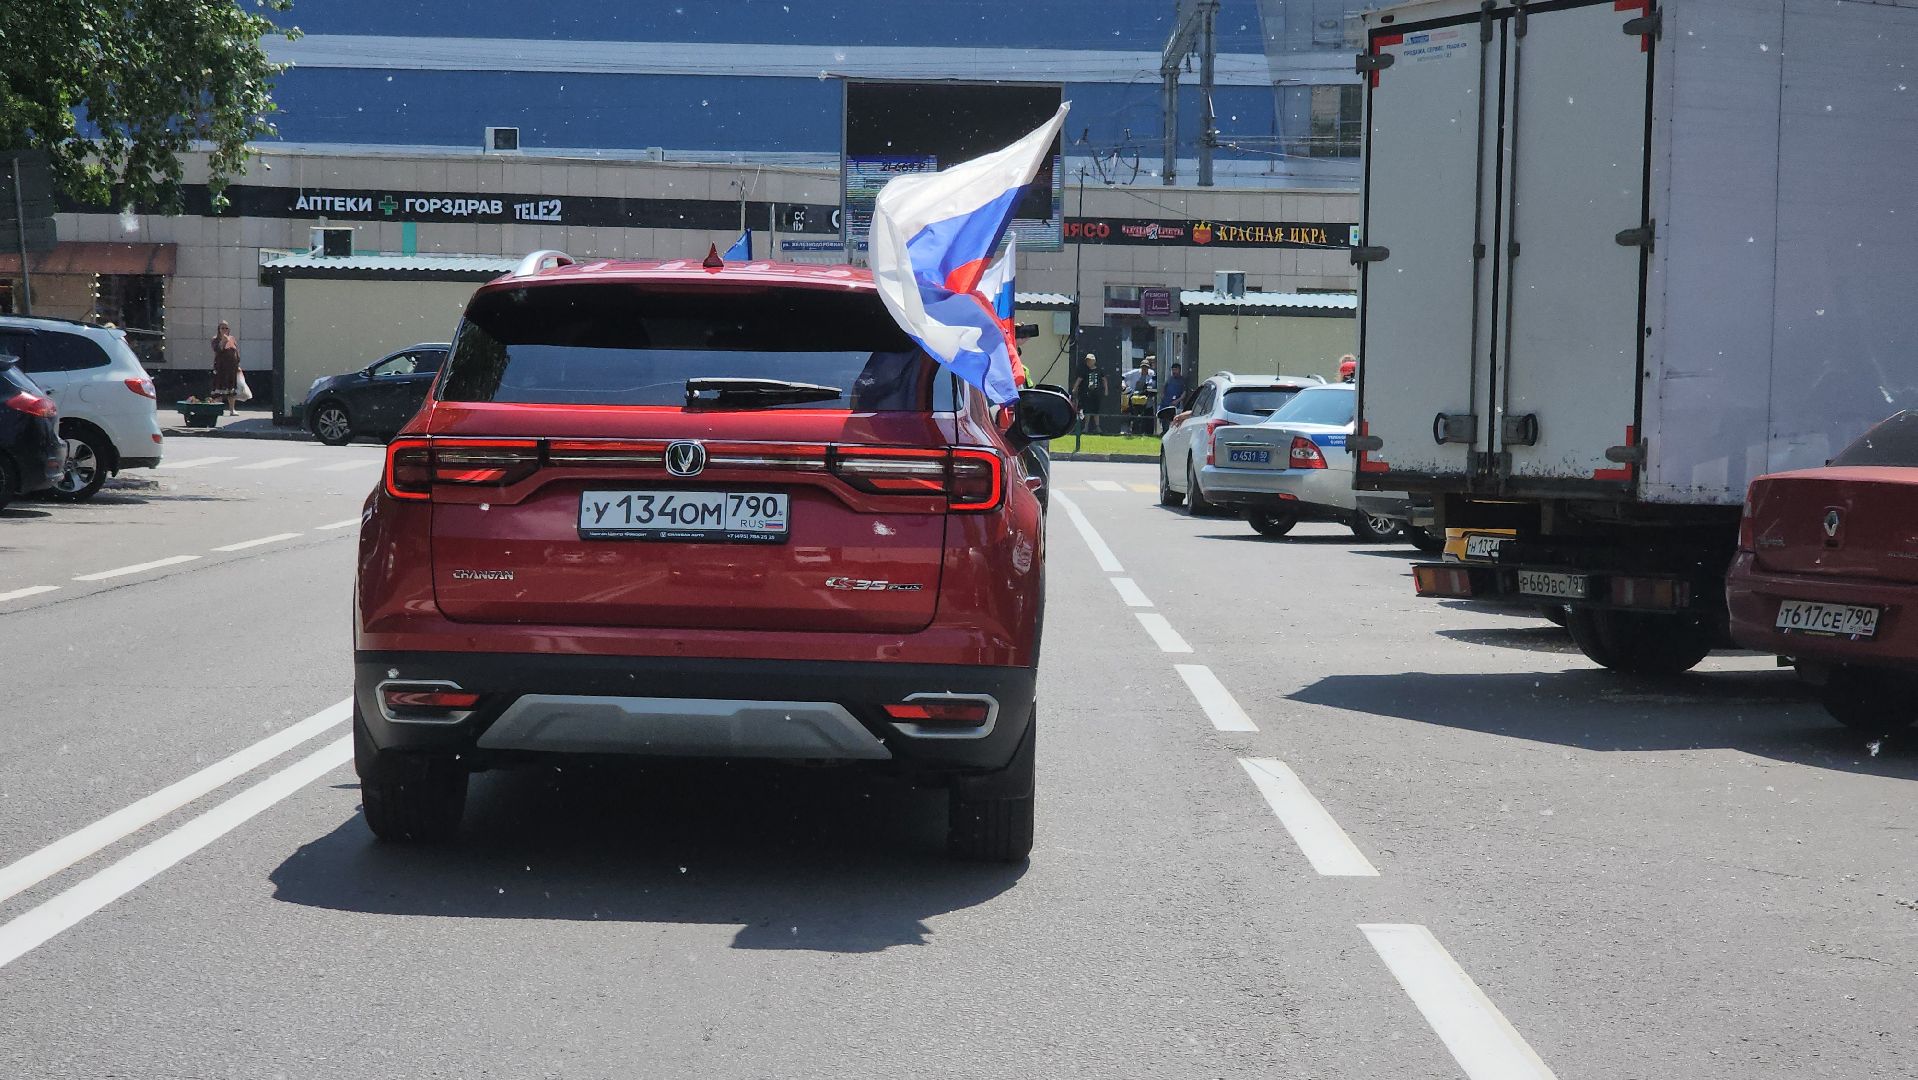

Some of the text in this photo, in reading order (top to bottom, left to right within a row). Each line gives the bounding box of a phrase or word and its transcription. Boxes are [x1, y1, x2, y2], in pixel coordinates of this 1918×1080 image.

[296, 196, 503, 216] АПТЕКИ ГОРЗДРАВ
[514, 199, 562, 222] TELE2
[1219, 224, 1284, 242] КРАСНАЯ
[1290, 227, 1327, 243] ИКРА
[729, 494, 778, 518] 790
[740, 519, 765, 528] RUS
[453, 570, 514, 580] CHANGAN
[887, 583, 922, 591] PLUS
[1784, 605, 1873, 629] Т617СЕ 790
